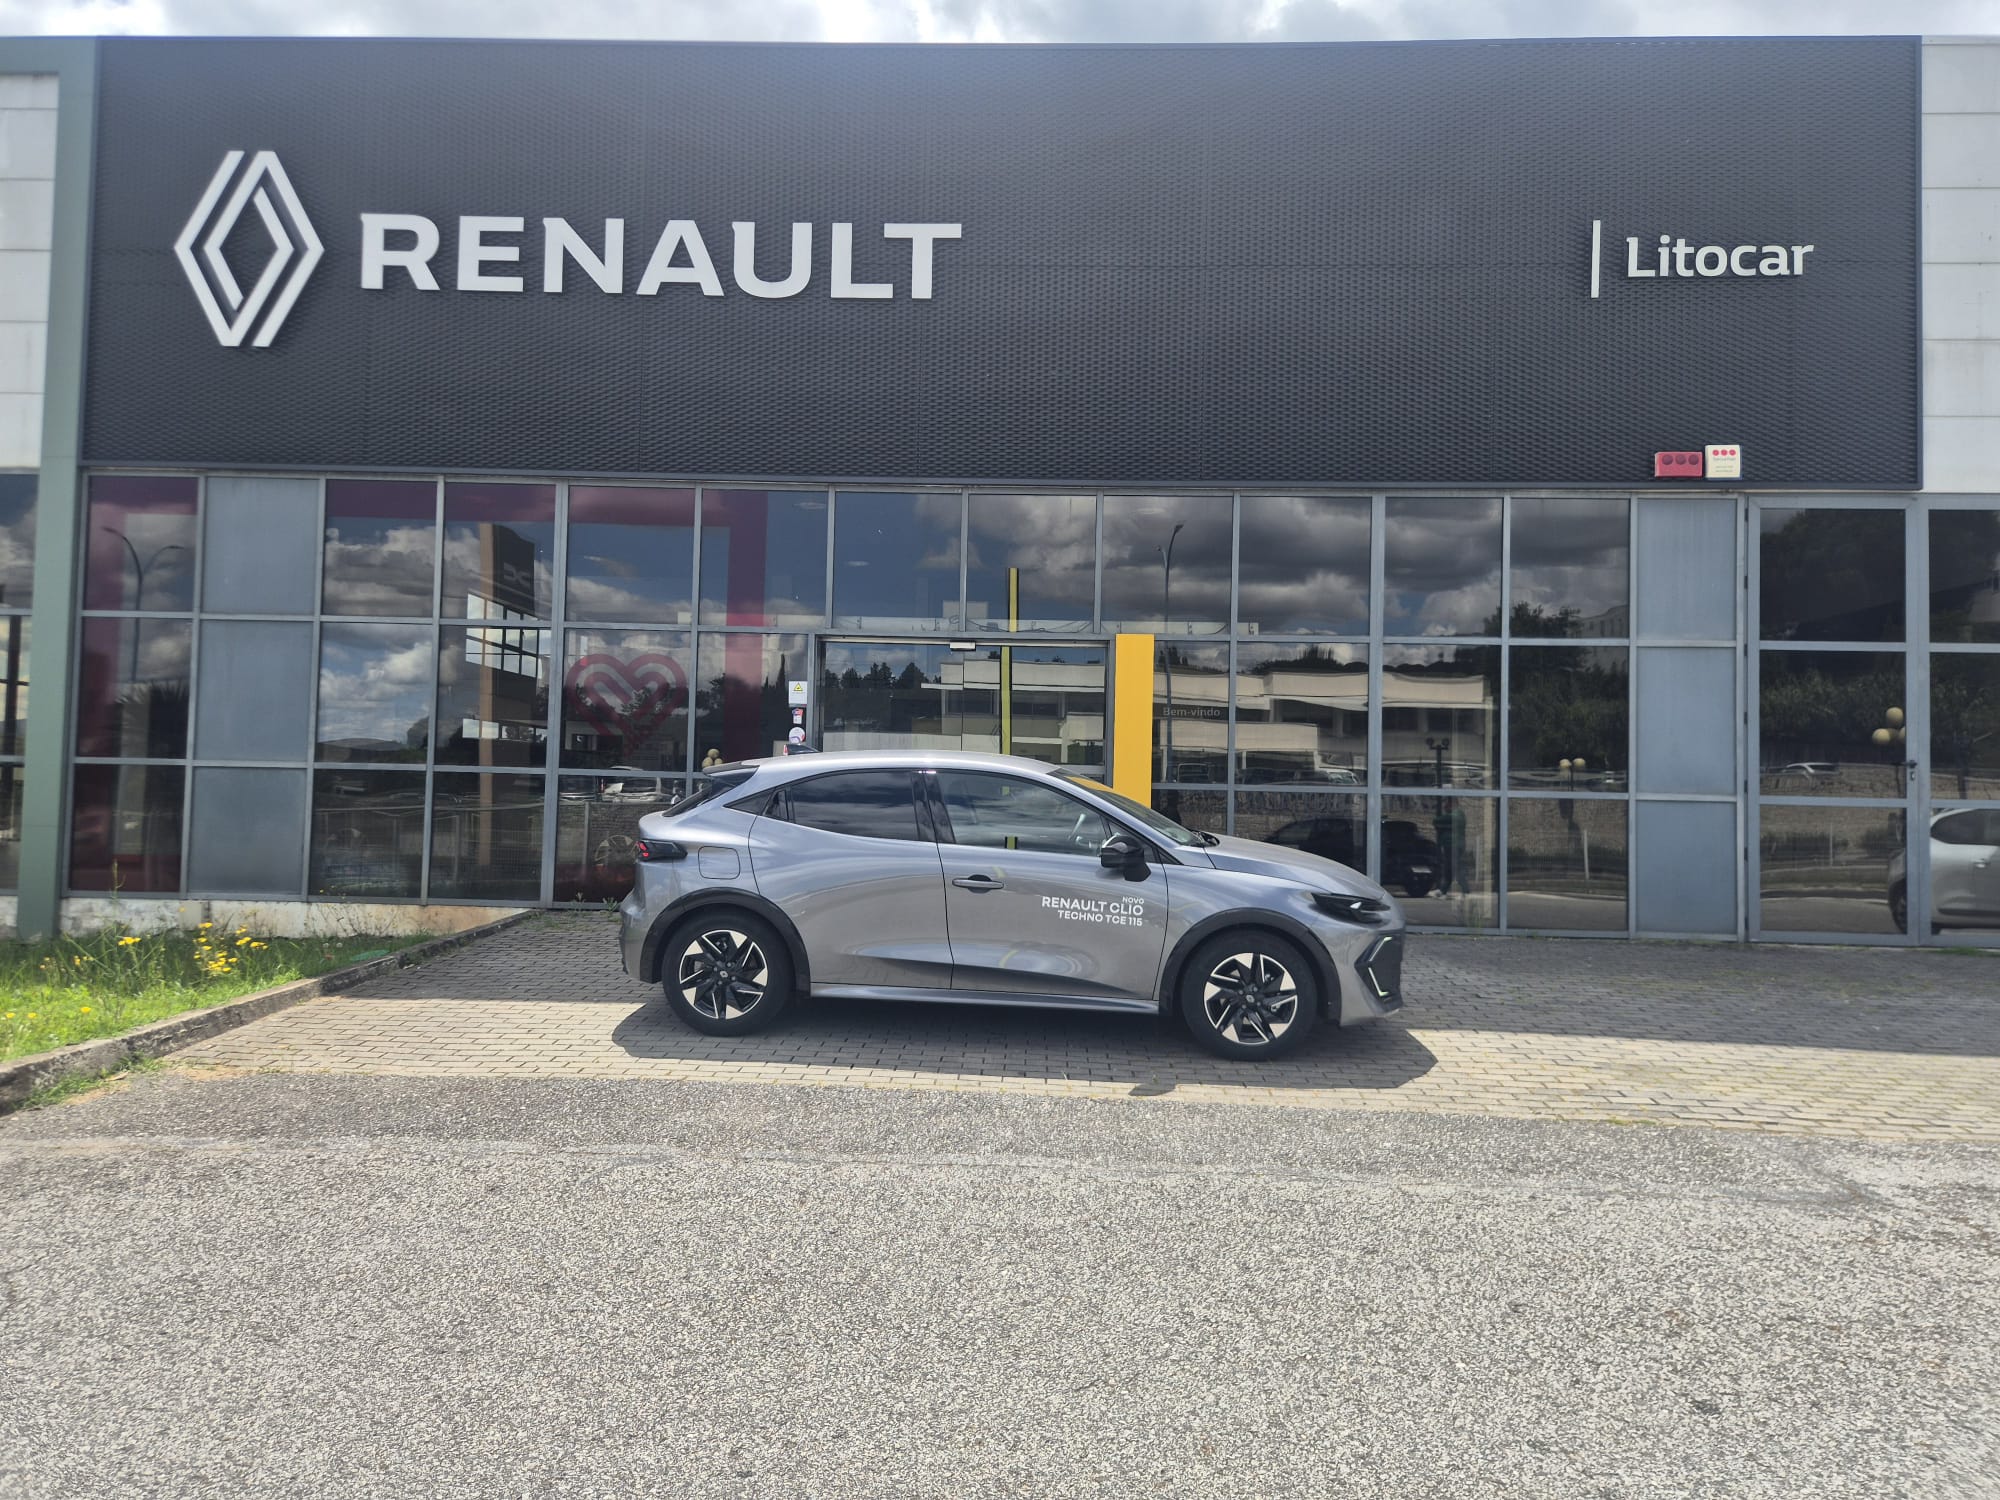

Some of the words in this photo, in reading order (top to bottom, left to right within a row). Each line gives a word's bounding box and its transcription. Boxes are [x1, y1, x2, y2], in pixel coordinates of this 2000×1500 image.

[360, 213, 962, 299] RENAULT
[1626, 234, 1814, 277] Litocar
[1163, 707, 1221, 716] Bem-vindo
[1042, 896, 1108, 913] RENAULT
[1109, 902, 1144, 916] CLIO
[1122, 896, 1145, 905] NOVO
[1058, 910, 1104, 922] TECHNO
[1105, 914, 1127, 925] TCE
[1128, 917, 1143, 927] 115
